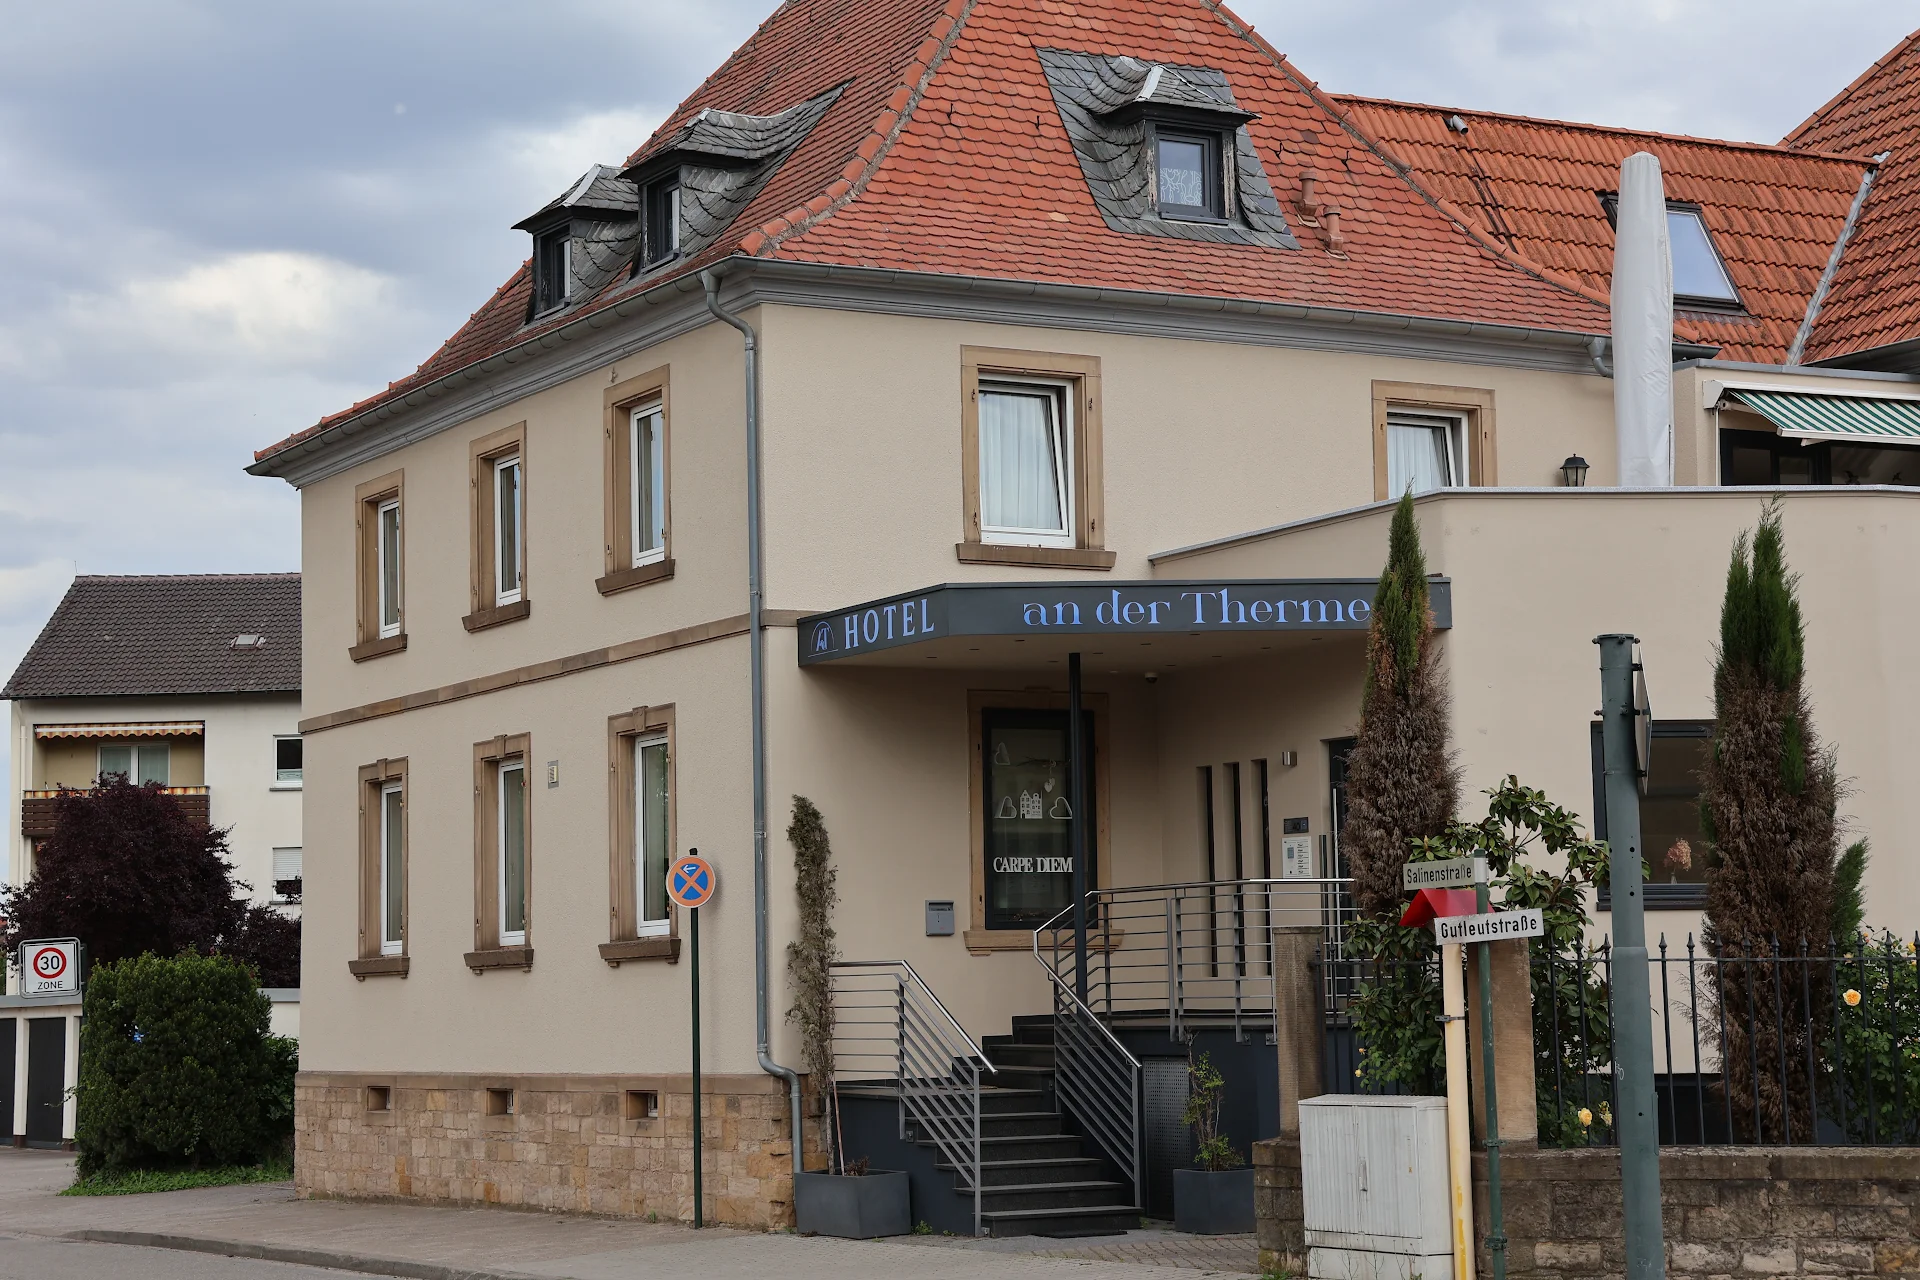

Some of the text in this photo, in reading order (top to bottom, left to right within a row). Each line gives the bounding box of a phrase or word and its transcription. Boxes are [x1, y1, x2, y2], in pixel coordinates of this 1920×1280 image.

[1022, 588, 1371, 626] an der Therme
[844, 598, 935, 650] HOTEL
[993, 857, 1074, 873] CARPE DIEM
[1406, 864, 1472, 884] Salinenstraße
[1440, 915, 1538, 939] Gutleutstraße
[40, 955, 60, 971] 30
[37, 980, 63, 990] ZONE
